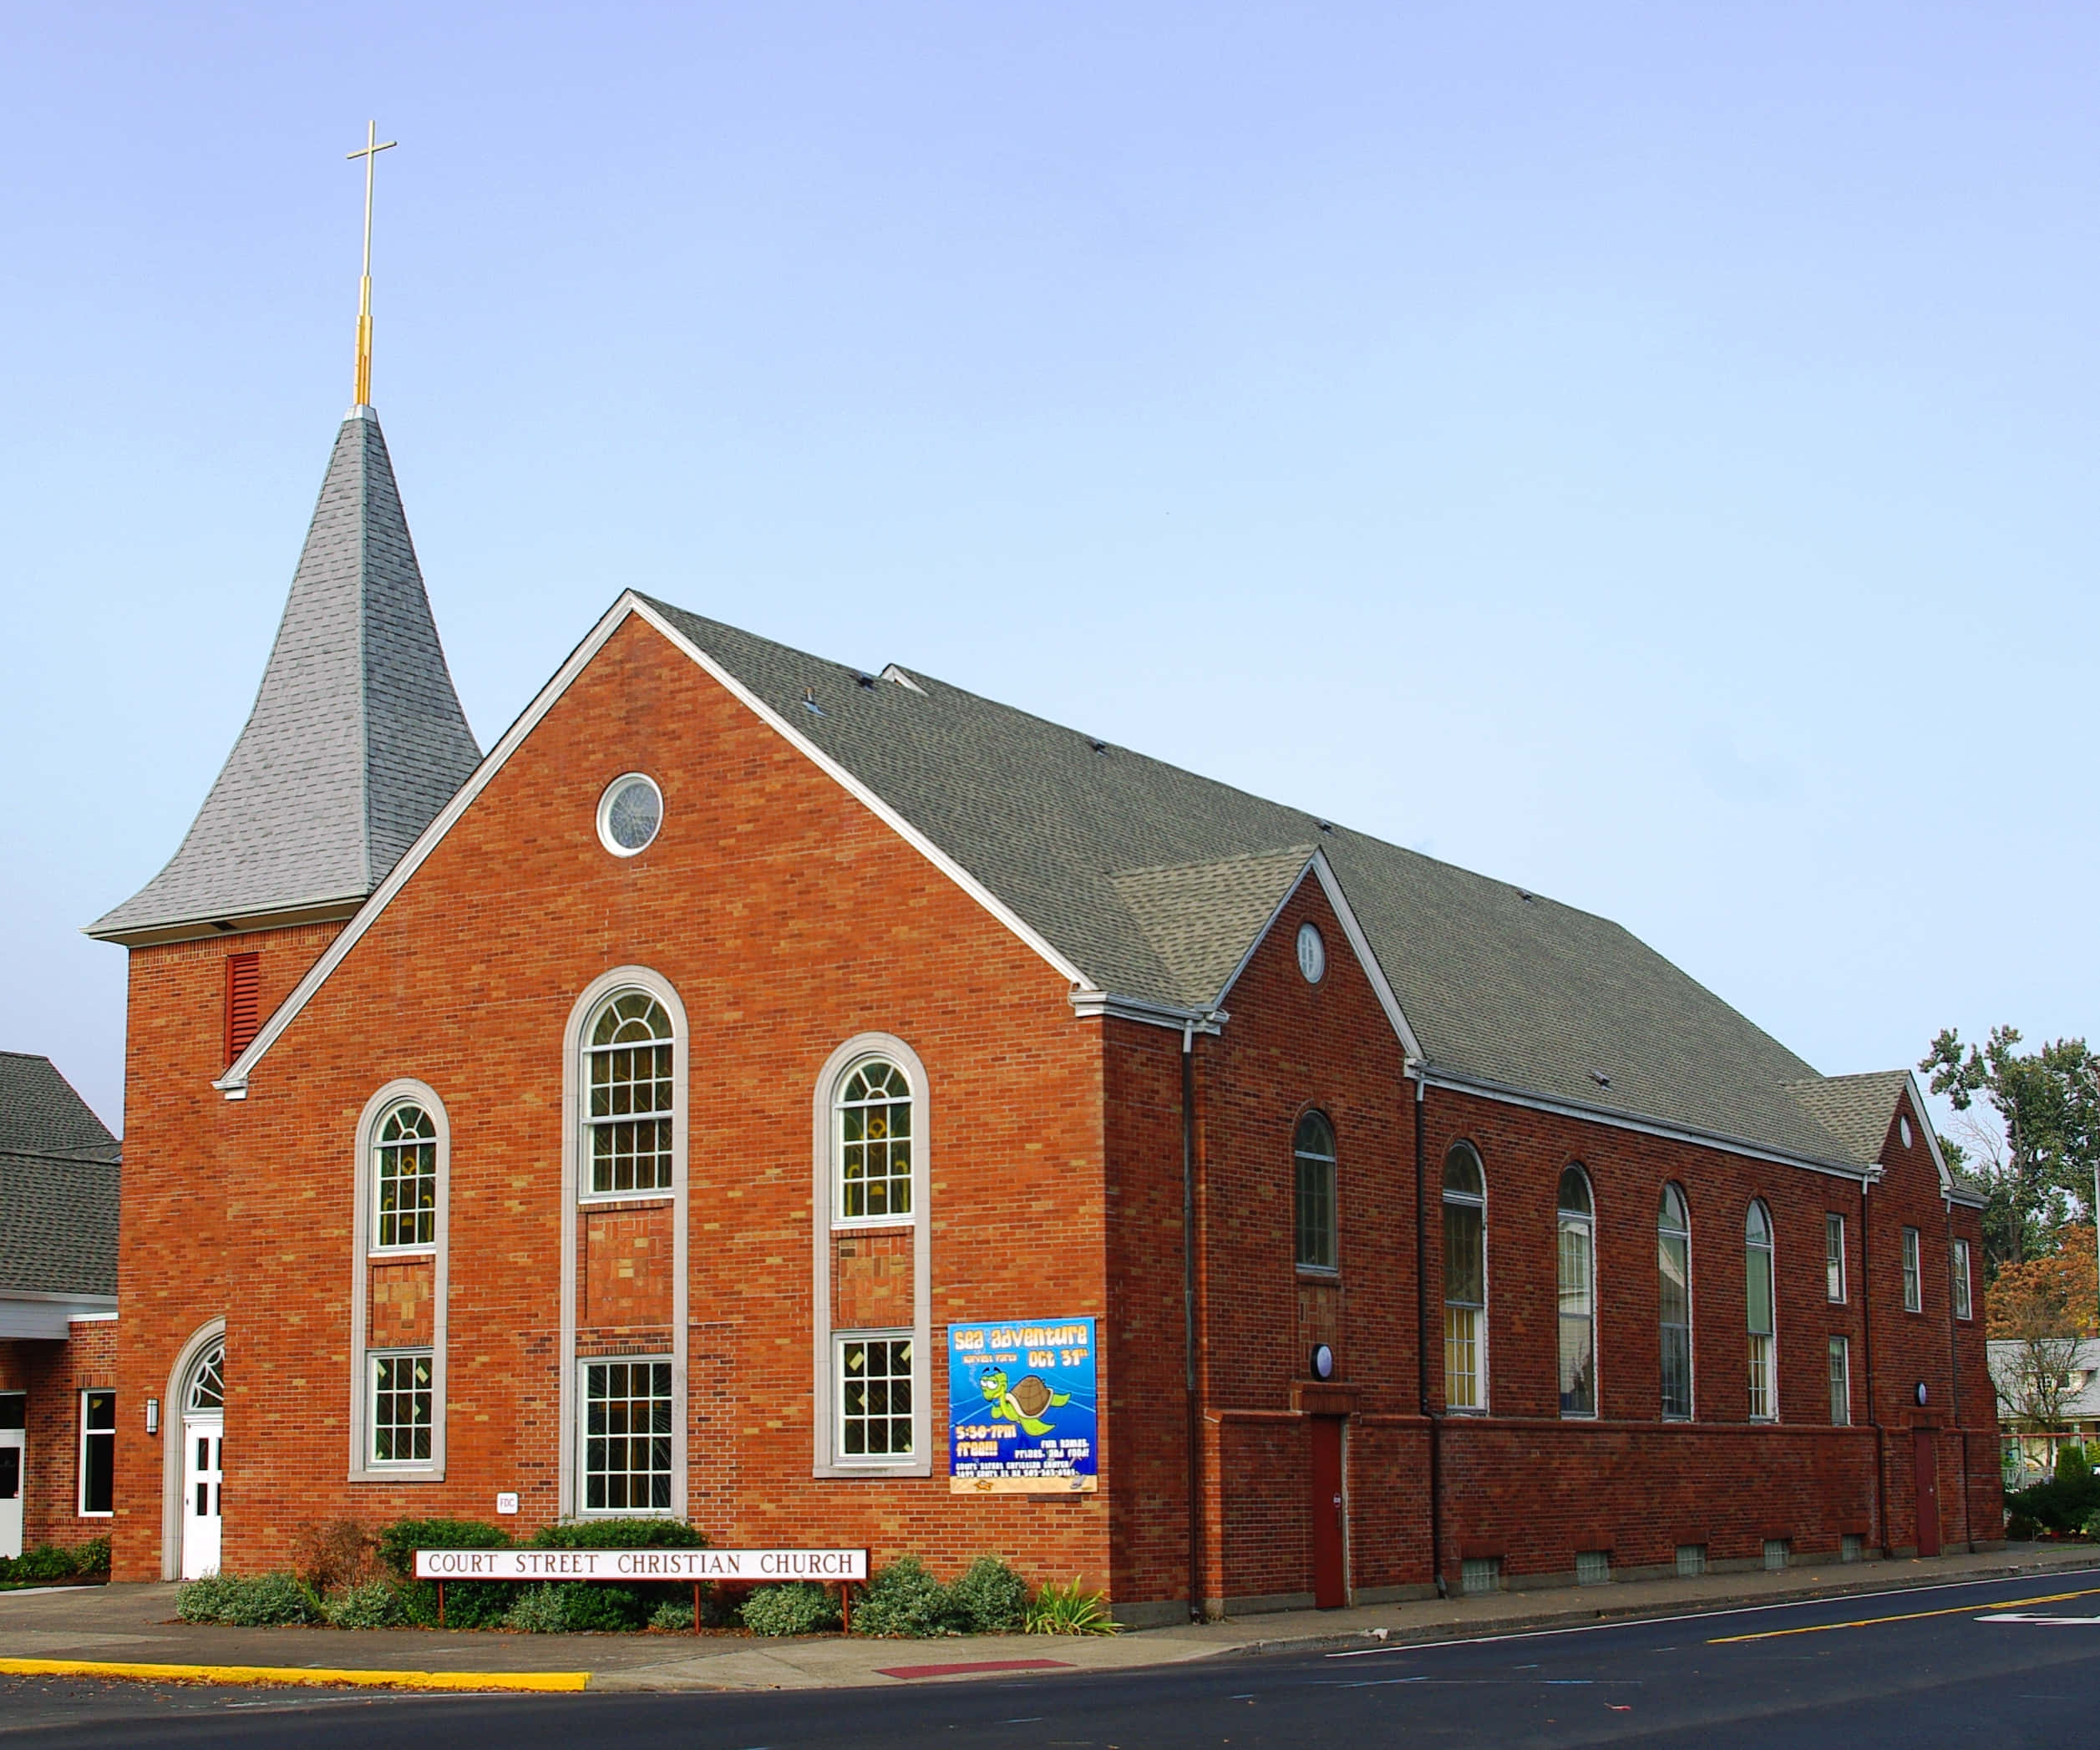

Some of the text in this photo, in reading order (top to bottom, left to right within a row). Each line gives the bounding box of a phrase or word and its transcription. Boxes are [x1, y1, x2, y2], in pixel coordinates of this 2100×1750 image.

[500, 1498, 515, 1508] FDC
[429, 1554, 854, 1574] COURT STREET CHRISTIAN CHURCH
